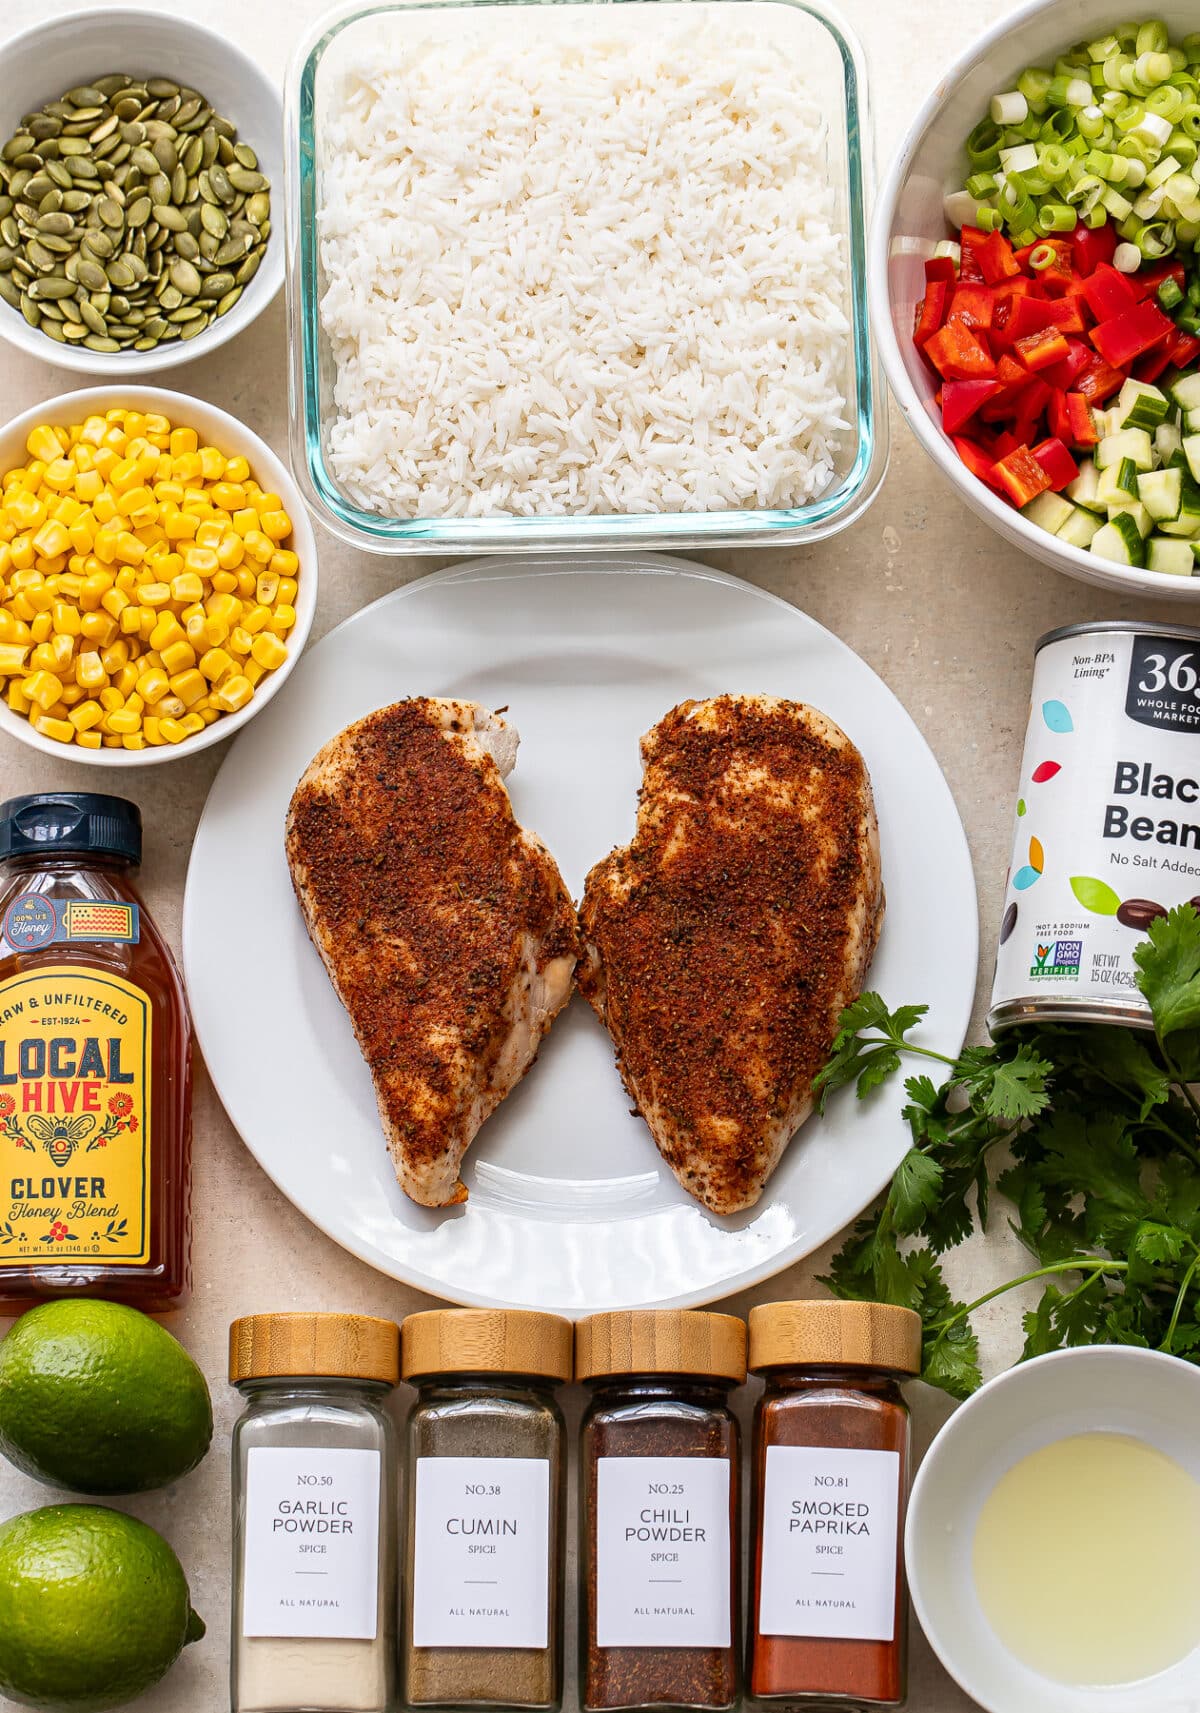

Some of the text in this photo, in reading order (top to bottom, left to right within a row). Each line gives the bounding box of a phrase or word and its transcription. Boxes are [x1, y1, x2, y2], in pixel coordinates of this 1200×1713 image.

[1072, 653, 1116, 665] Non-BPA
[1137, 698, 1177, 710] WHOLE
[1153, 711, 1200, 725] MARKET
[1113, 761, 1200, 803] Blac
[1102, 805, 1200, 850] Bean
[1110, 853, 1129, 865] No
[1132, 854, 1157, 869] Salt
[11, 921, 51, 936] Honey
[1057, 943, 1080, 951] NON
[1056, 951, 1080, 959] GMO
[1092, 953, 1120, 968] NET WT
[1032, 967, 1077, 975] VERIFIED
[1090, 969, 1100, 982] 15
[1111, 970, 1137, 989] (425g
[28, 997, 40, 1009] &
[44, 993, 128, 1025] UNFILTERED
[0, 1037, 134, 1085] LOCAL
[22, 1081, 101, 1114] HIVE
[11, 1176, 106, 1200] CLOVER
[8, 1200, 119, 1224] Honey Blend
[297, 1475, 333, 1487] NO.50
[814, 1475, 849, 1489] NO.81
[465, 1484, 501, 1496] NO.38
[648, 1483, 684, 1495] NO.25
[278, 1500, 348, 1515] GARLIC
[791, 1500, 870, 1518] SMOKED
[640, 1509, 690, 1524] CHILI
[273, 1519, 353, 1534] POWDER
[446, 1518, 517, 1535] CUMIN
[789, 1519, 870, 1536] PAPRIKA
[625, 1528, 706, 1543] POWDER
[298, 1545, 327, 1554] SPICE
[468, 1545, 496, 1554] SPICE
[815, 1545, 844, 1555] SPICE
[650, 1553, 679, 1562] SPICE
[279, 1599, 340, 1608] ALL NATURAL
[795, 1599, 857, 1610] ALL NATURAL
[449, 1608, 510, 1617] ALL NATURAL
[634, 1607, 695, 1616] ALL NATURAL
